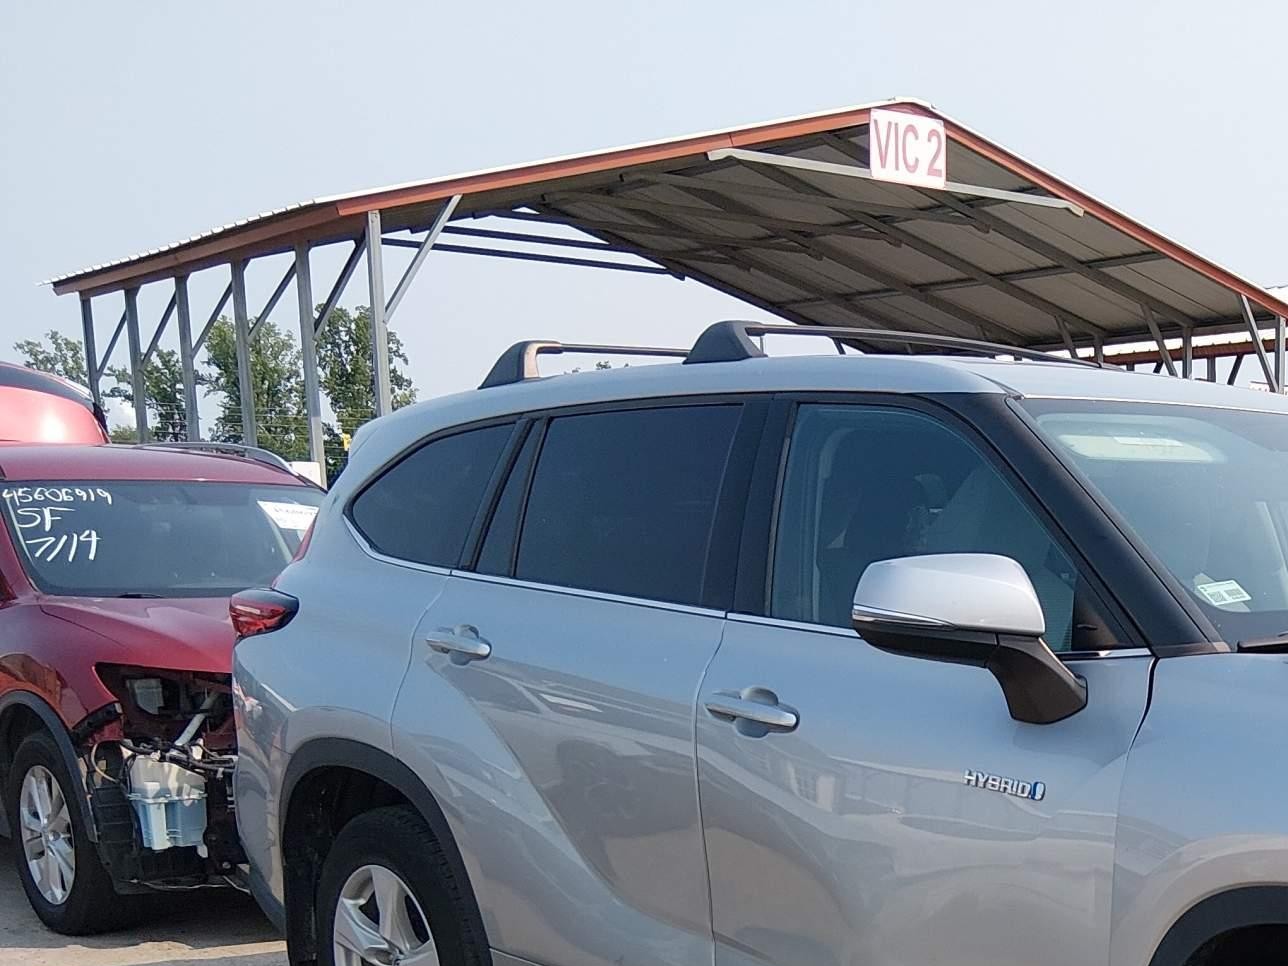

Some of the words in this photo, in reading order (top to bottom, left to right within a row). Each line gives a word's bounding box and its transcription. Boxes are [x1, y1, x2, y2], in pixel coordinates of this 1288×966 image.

[873, 119, 920, 174] VIC
[926, 128, 943, 178] 2
[2, 487, 112, 506] 45606919
[17, 506, 76, 532] SF
[25, 530, 102, 562] 7/14
[963, 768, 1031, 799] HYBRID
